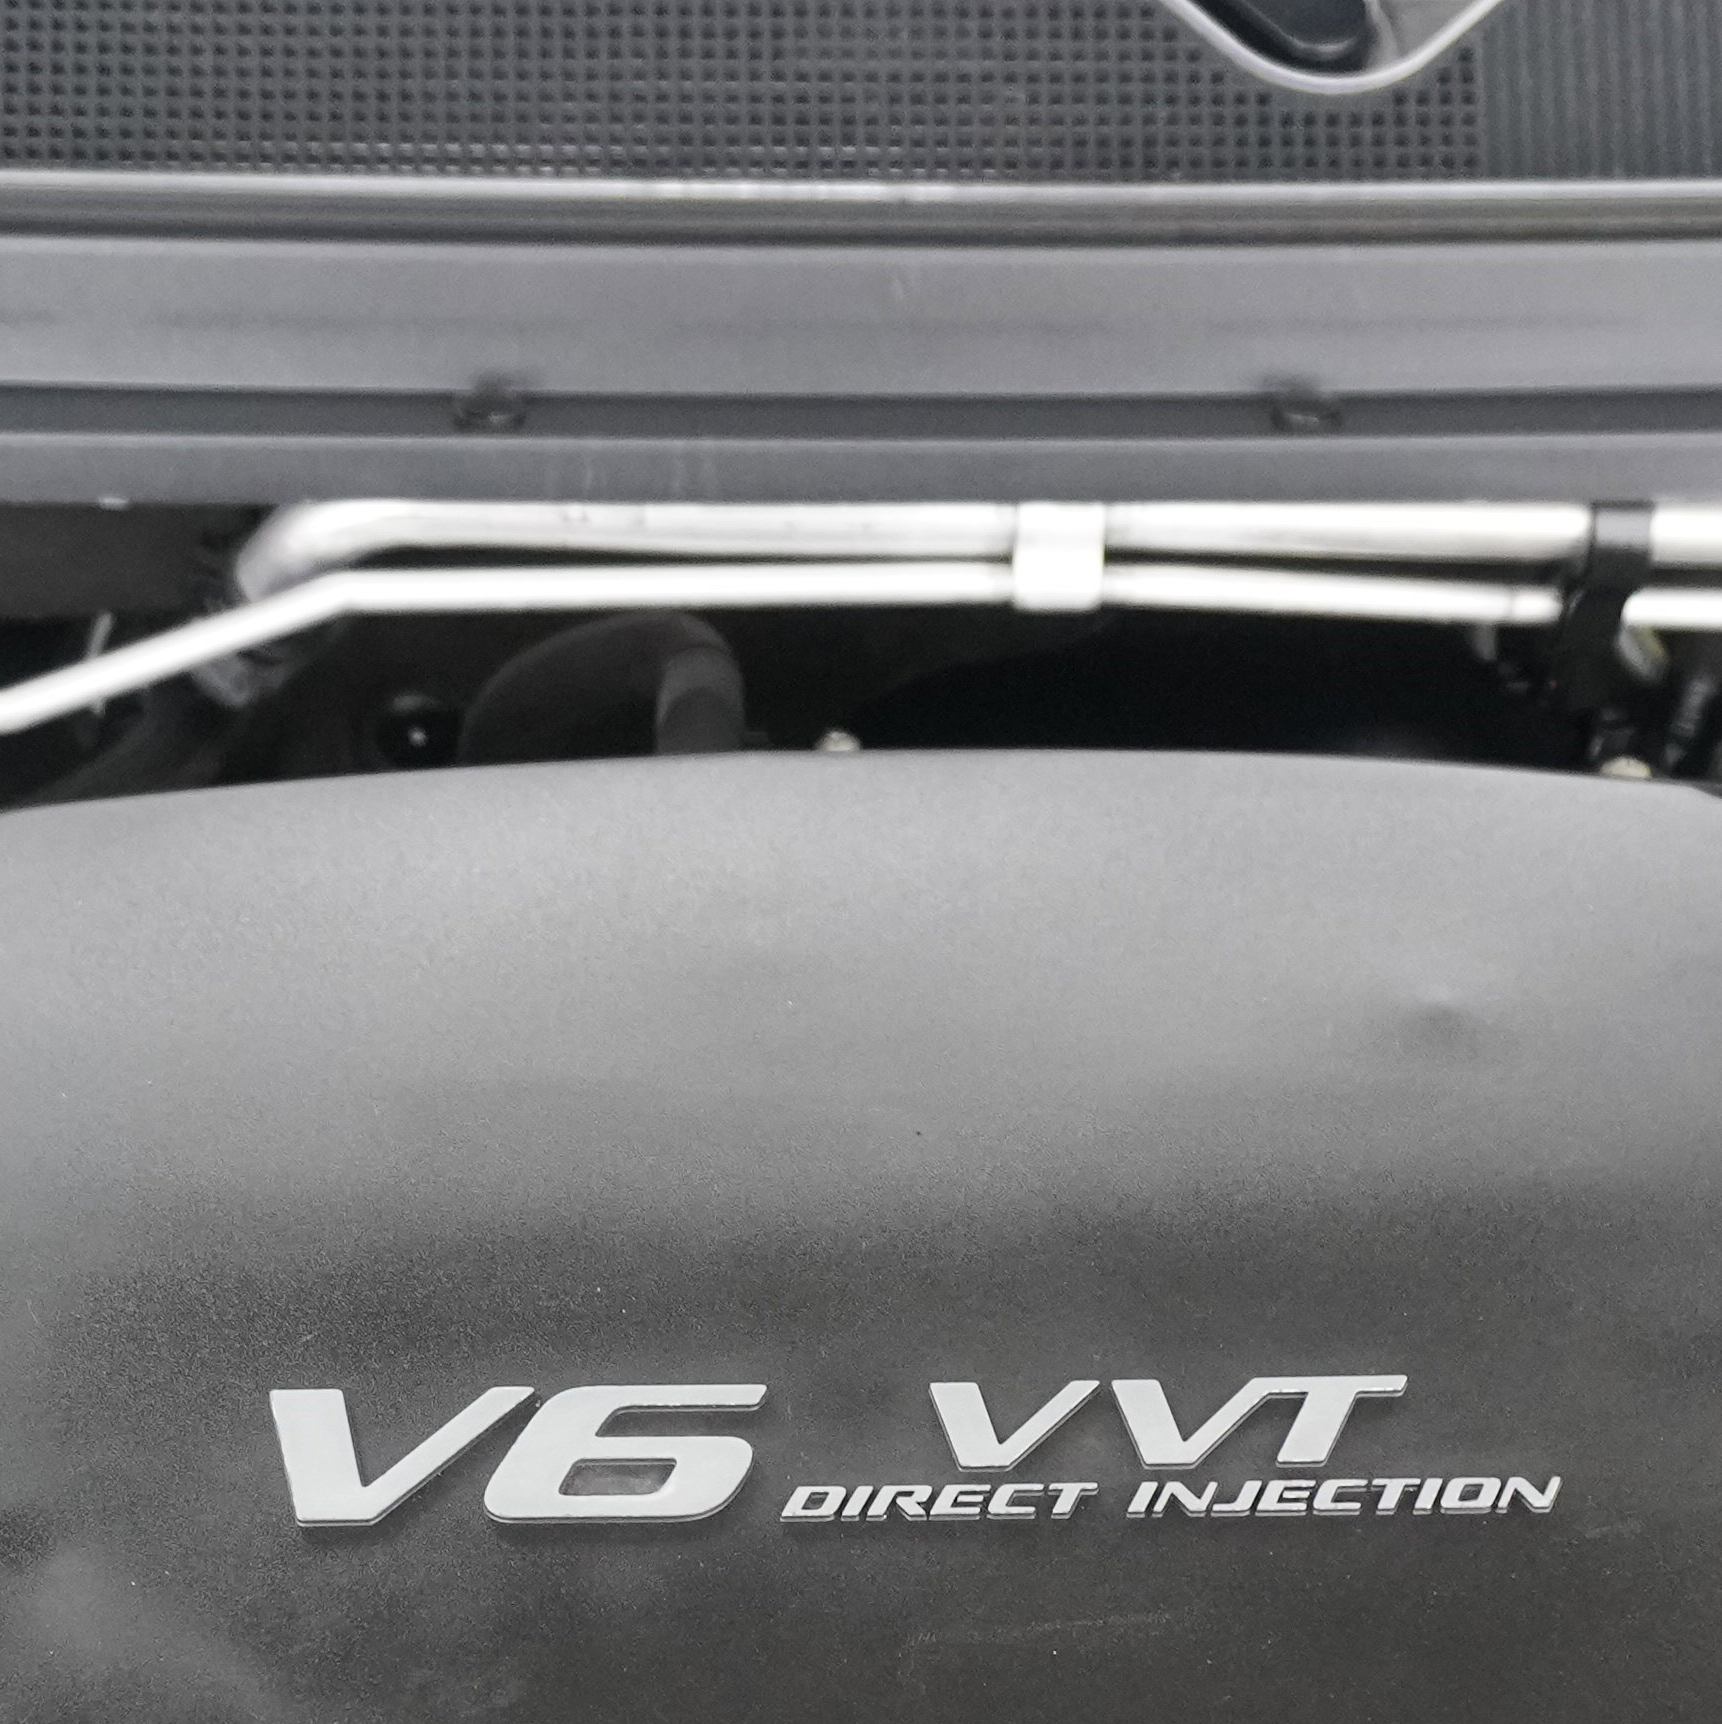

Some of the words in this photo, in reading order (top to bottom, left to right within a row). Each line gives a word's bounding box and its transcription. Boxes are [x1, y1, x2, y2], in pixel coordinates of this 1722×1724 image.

[269, 1384, 768, 1526] V6
[928, 1374, 1408, 1472] VVT
[779, 1482, 1099, 1520] DIRECT
[1125, 1475, 1563, 1518] INJECTION
